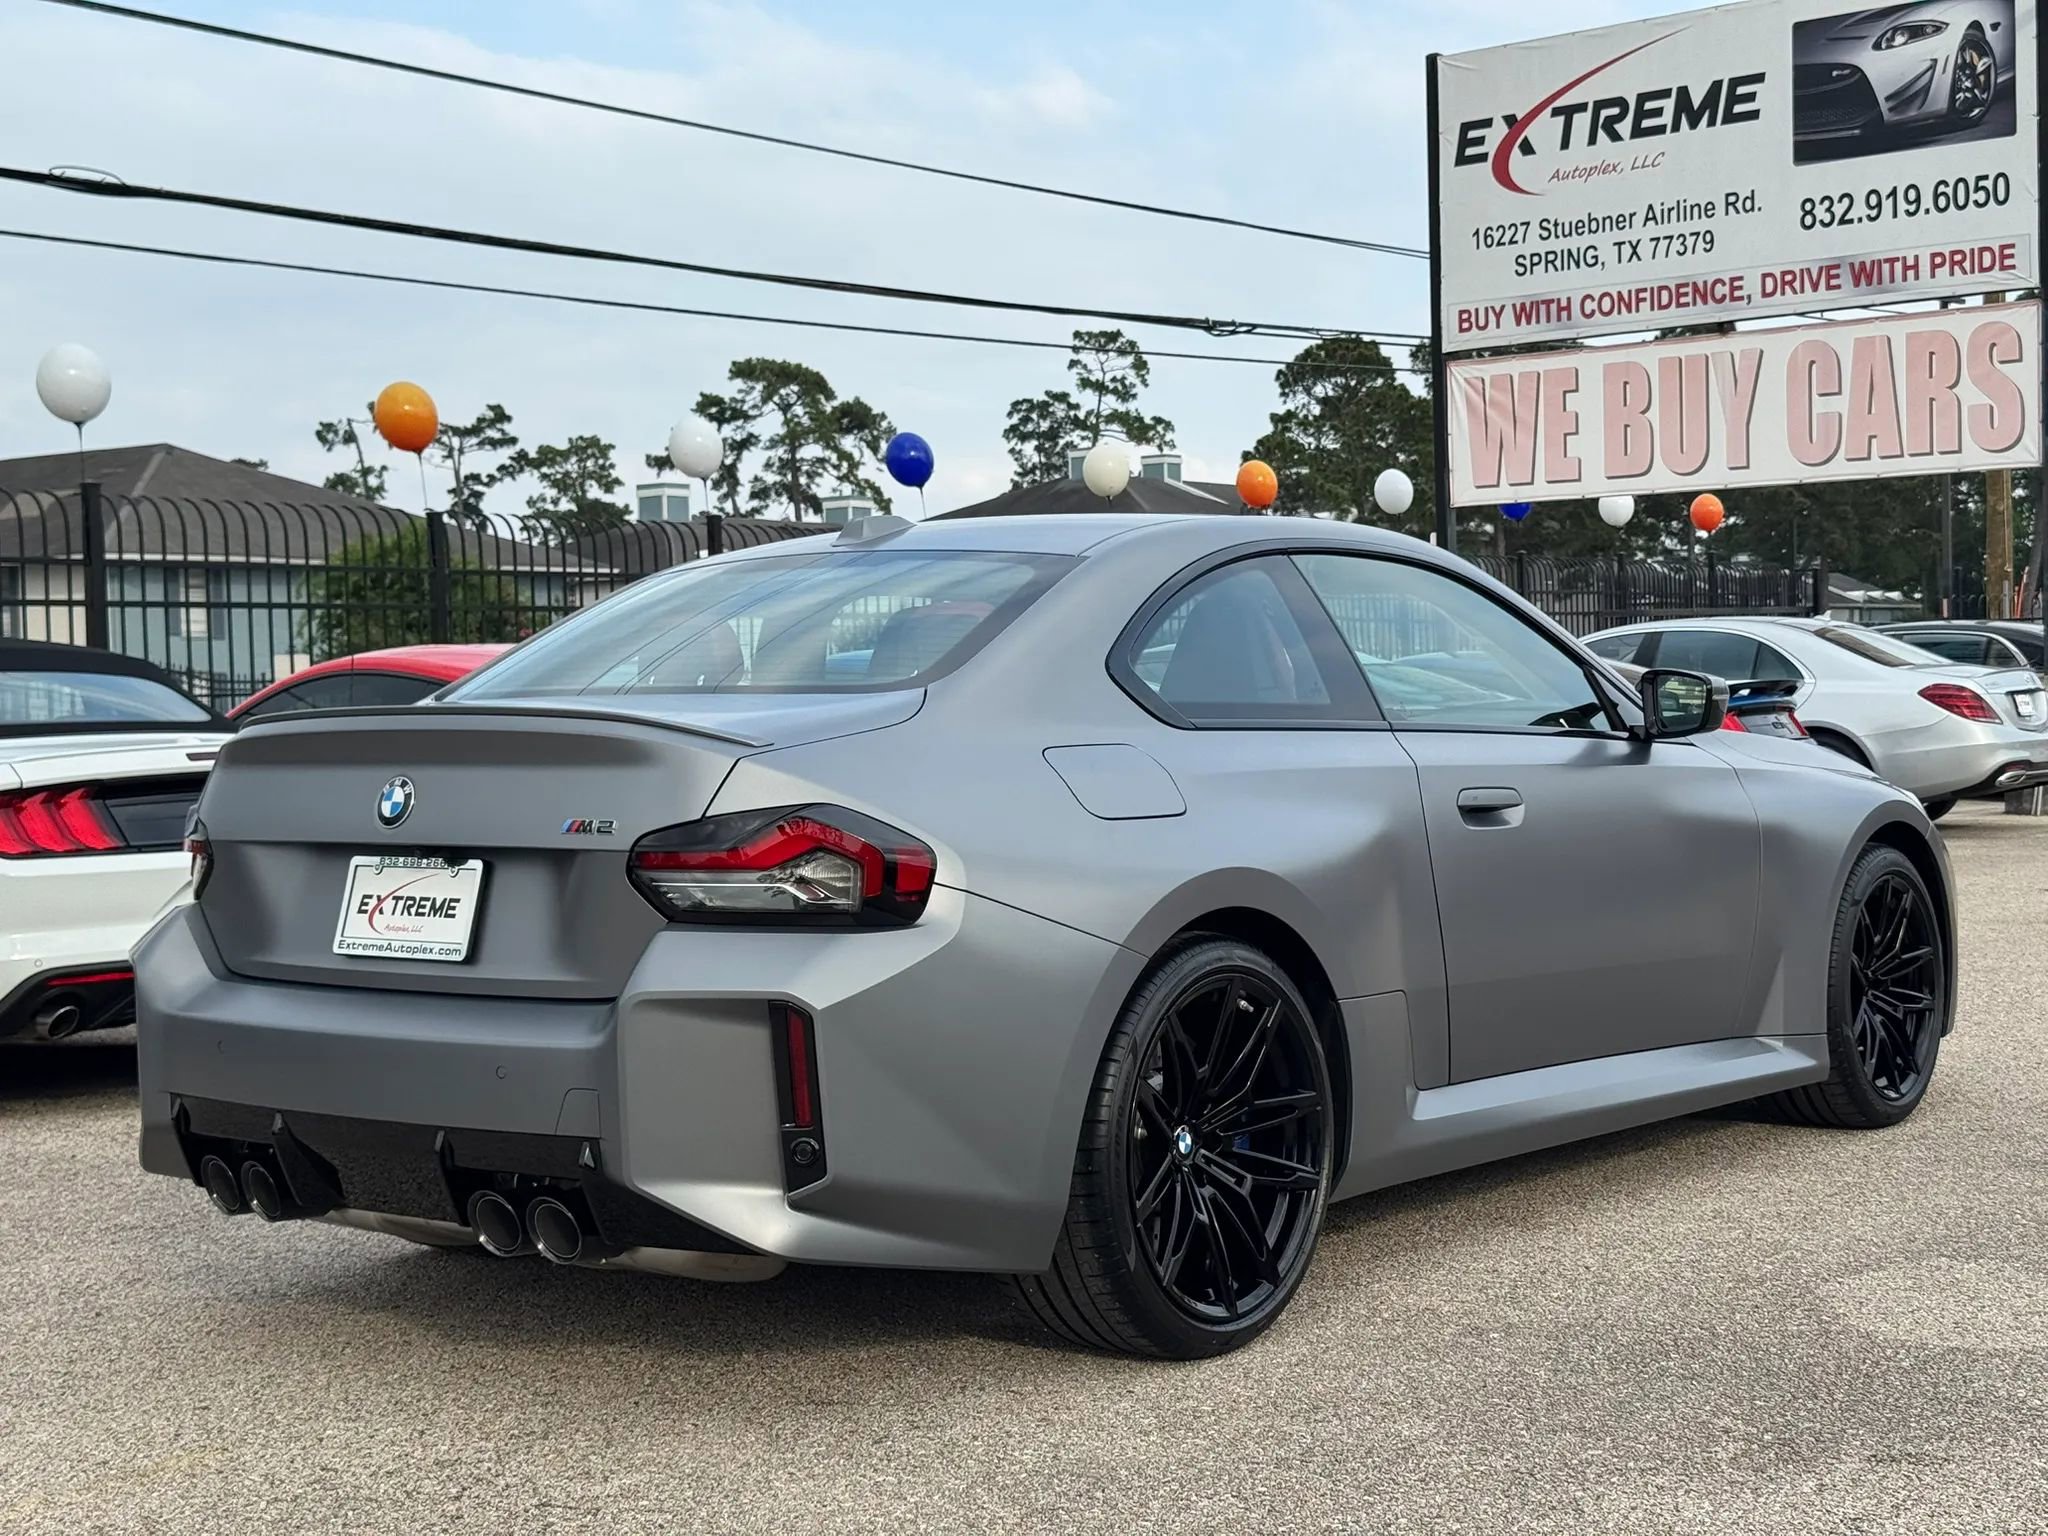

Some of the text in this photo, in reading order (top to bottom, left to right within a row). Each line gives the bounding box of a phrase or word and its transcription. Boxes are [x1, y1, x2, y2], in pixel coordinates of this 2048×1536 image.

[1454, 71, 1767, 168] EXTREME
[1548, 151, 1665, 184] Autoplex, LLC
[1471, 189, 1763, 250] 16227 Stuebner Airline Rd.
[1800, 171, 2011, 231] 832.919.6050
[1514, 229, 1715, 277] SPRING, TX 77379
[1457, 243, 2017, 334] BUY WITH CONFIDENCE, DRIVE WITH PRIDE
[1464, 320, 2026, 489] WE BUY CARS
[574, 818, 617, 834] M2
[356, 893, 462, 919] EXTREME
[337, 939, 462, 957] ExtremeAutoplex.com
